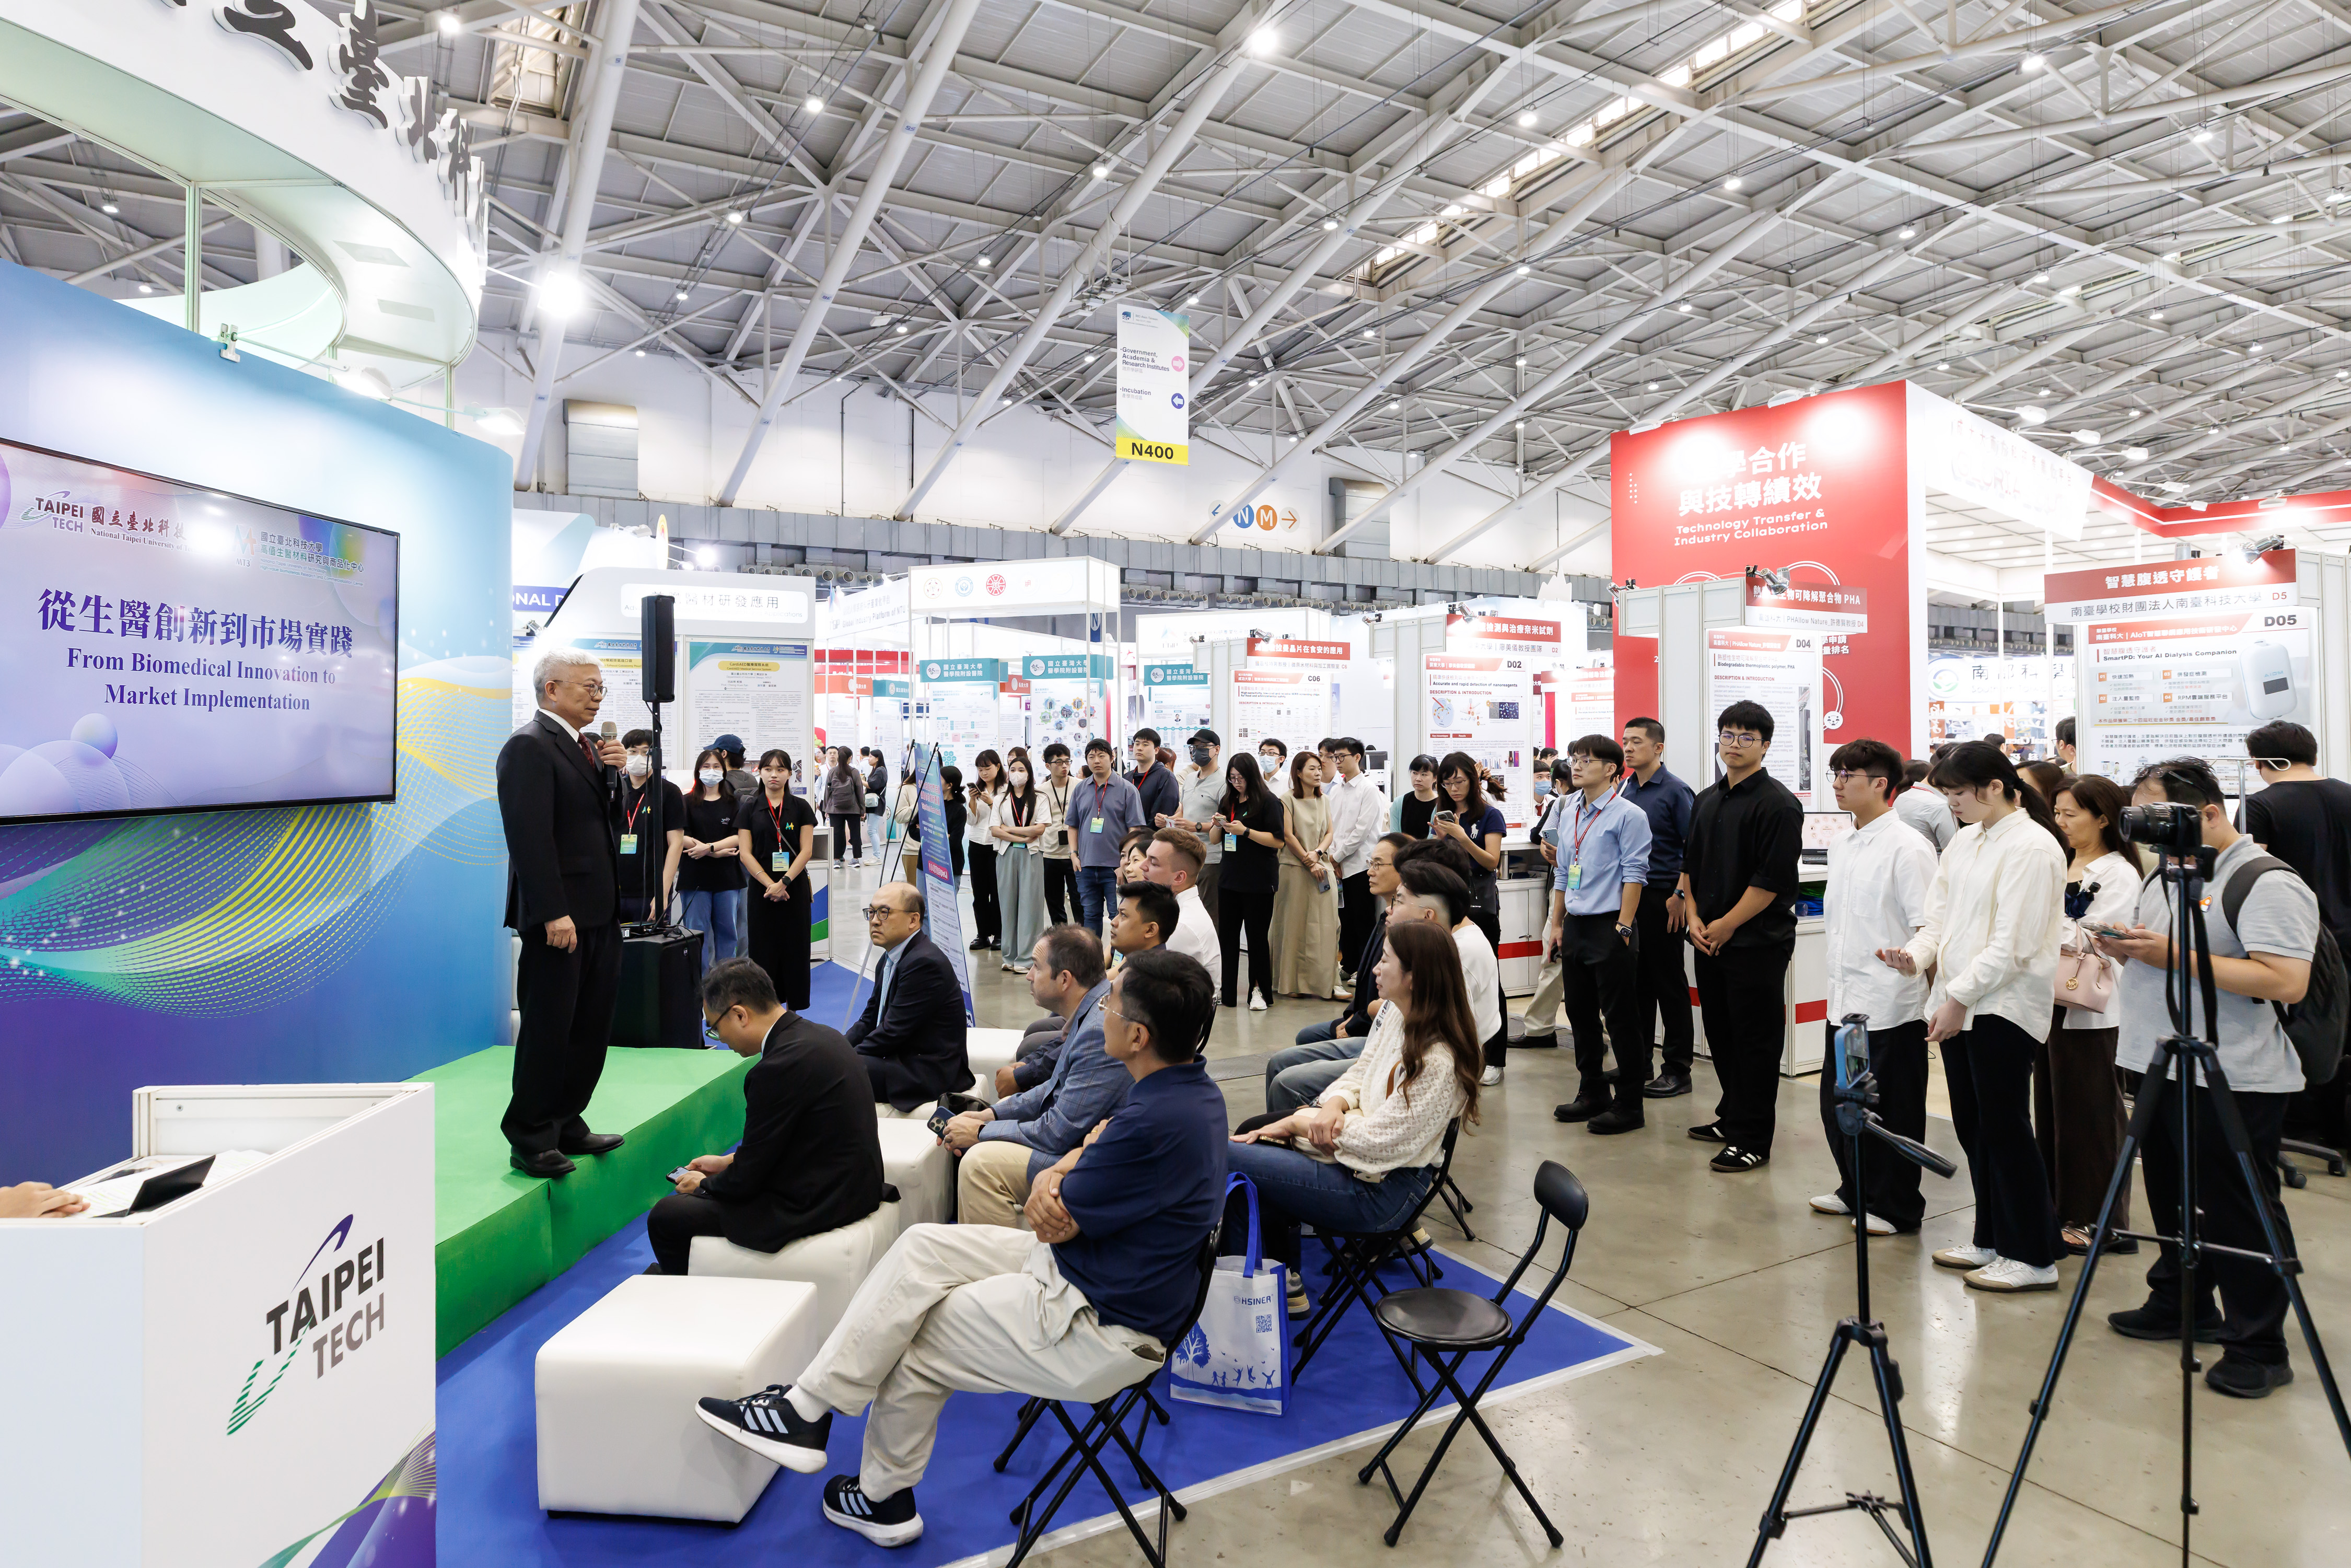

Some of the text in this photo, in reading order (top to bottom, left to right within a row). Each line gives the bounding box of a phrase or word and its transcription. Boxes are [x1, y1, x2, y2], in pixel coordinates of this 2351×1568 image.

[1122, 347, 1158, 357] Government,
[1122, 354, 1149, 362] Academia
[1122, 387, 1151, 396] Incubation
[1132, 442, 1173, 460] N400
[1679, 472, 1822, 517] 與技轉績效
[35, 497, 84, 518] TAIPEI
[1238, 507, 1249, 524] N
[52, 516, 83, 532] TECH
[1260, 509, 1274, 526] M
[1676, 508, 1825, 535] Technology Transfer &
[91, 528, 183, 550] National Taipei University of
[261, 531, 322, 553] 國立臺北科技大學
[1674, 521, 1828, 546] Industry Collaboration
[260, 544, 364, 573] 高值生醫材料研究與商品化中心
[2105, 565, 2220, 589] 智慧腹透守護者
[1844, 594, 1860, 605] PHA
[2070, 591, 2288, 618] 南臺學校財團法人南臺科技大學 D5
[872, 611, 890, 620] Platform
[897, 606, 906, 615] NTU
[1787, 616, 1809, 624] PHAllow
[2264, 615, 2297, 626] D05
[38, 588, 353, 659] 從生醫創新到市場實踐
[1255, 643, 1343, 655] 高拉曼晶片在食安的應用
[1499, 643, 1542, 653] 廖美儀教授團隊
[1796, 639, 1811, 648] D04
[2103, 646, 2156, 655] 智慧腹透守護者
[66, 647, 336, 685] From Biomedical Innovation to
[104, 683, 310, 712] Market Implementation
[266, 1236, 384, 1355] TAIPEI
[1241, 1295, 1272, 1306] HSINER
[312, 1292, 384, 1379] TECH
